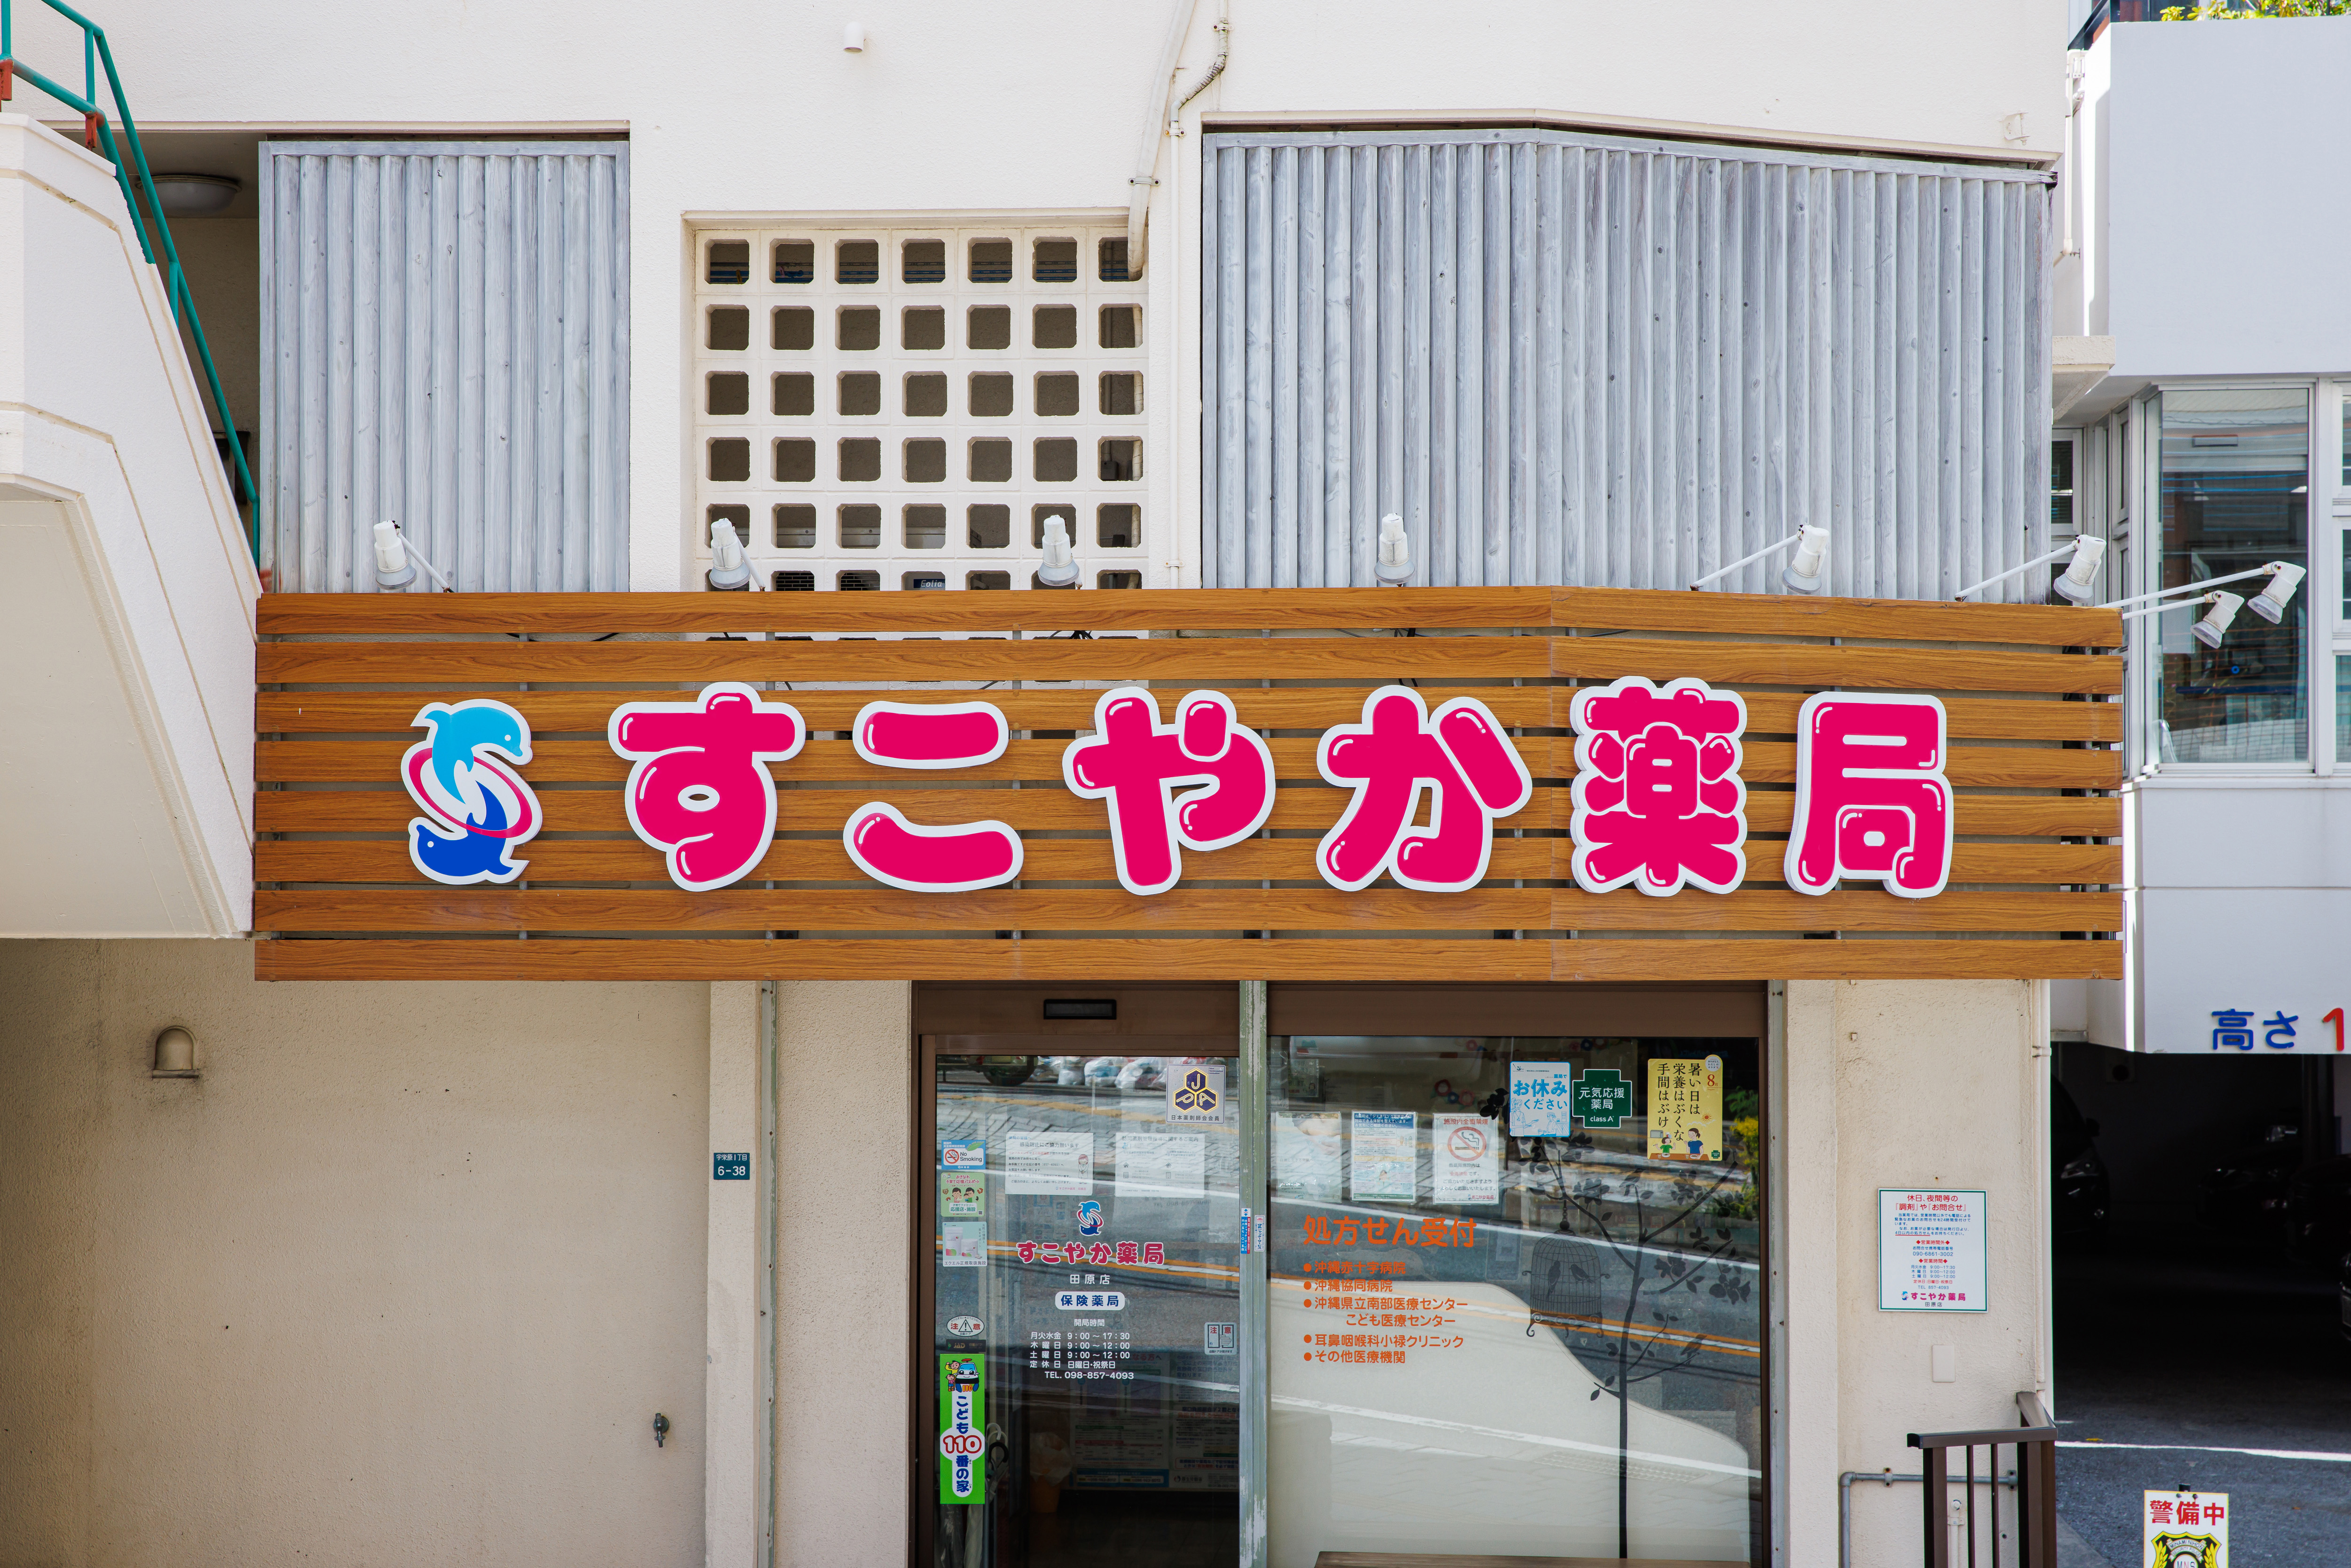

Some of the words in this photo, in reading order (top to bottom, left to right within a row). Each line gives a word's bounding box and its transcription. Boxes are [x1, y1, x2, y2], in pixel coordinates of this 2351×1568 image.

[609, 676, 1953, 897] すこやか薬局
[2211, 1009, 2298, 1050] 高さ
[1707, 1074, 1718, 1087] 8月
[1513, 1079, 1567, 1097] お休み
[1578, 1087, 1625, 1099] 元気応援
[1688, 1063, 1702, 1115] 暑い日は
[1657, 1063, 1670, 1127] 手間はぶけ
[1523, 1098, 1567, 1110] ください
[1591, 1099, 1613, 1109] 薬局
[1673, 1063, 1686, 1141] 栄養はぶくな
[718, 1166, 745, 1175] 6-38
[1895, 1203, 1966, 1212] 『調剤』や『お問合せ』
[1303, 1215, 1477, 1247] 処方せん受付
[1016, 1240, 1164, 1265] すこやか薬局
[1315, 1261, 1406, 1274] 沖縄赤十字病院
[1070, 1274, 1110, 1284] 田原店
[1315, 1279, 1393, 1292] 沖縄協同病院
[1061, 1295, 1119, 1307] 保険薬局
[1911, 1292, 1966, 1301] すこやか薬局
[1315, 1297, 1467, 1310] 沖縄県立南部医療センター
[1346, 1314, 1455, 1327] こども医療センター
[1315, 1334, 1464, 1347] 耳鼻咽喉科小禄クリニック
[1315, 1350, 1405, 1363] その他医療機関
[2150, 1500, 2224, 1526] 警備中
[2172, 1546, 2189, 1554] SECURITY
[2189, 1547, 2201, 1557] POLICE
[2188, 1540, 2203, 1550] NIHON
